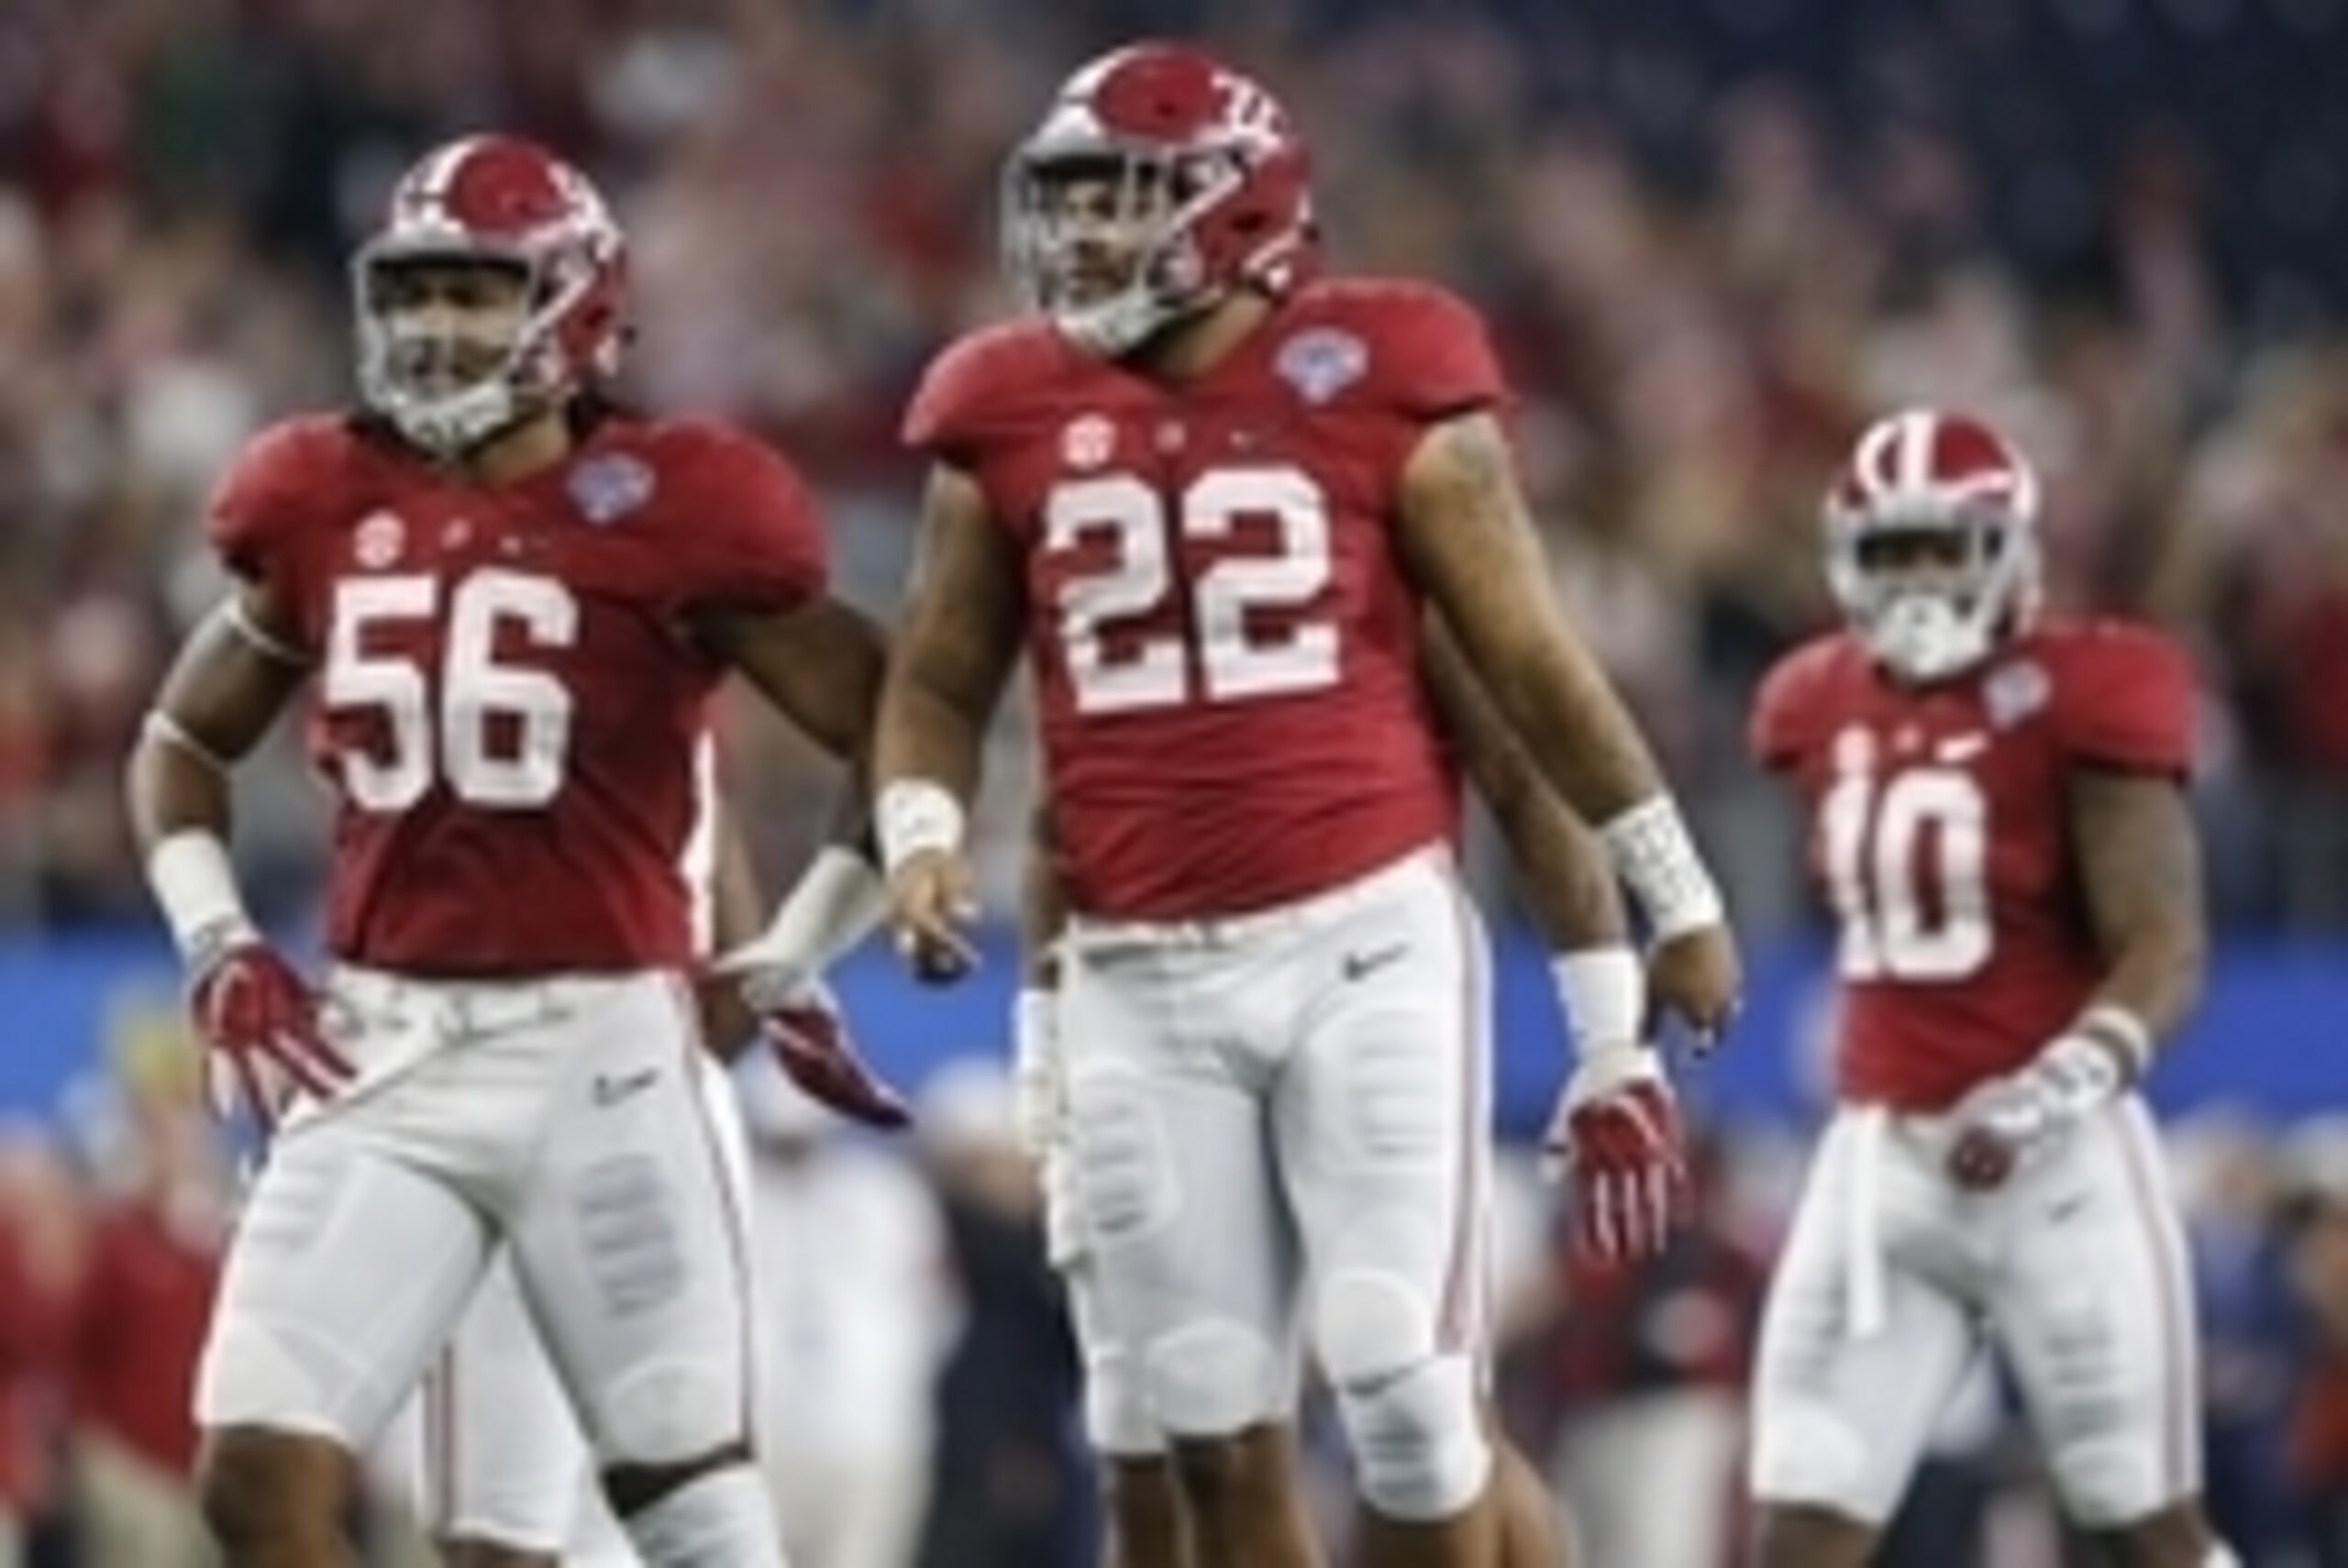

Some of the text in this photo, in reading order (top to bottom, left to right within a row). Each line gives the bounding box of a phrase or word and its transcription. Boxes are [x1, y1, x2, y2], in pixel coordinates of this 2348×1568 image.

[325, 567, 578, 812] 56
[1047, 467, 1340, 713] 22
[1822, 768, 1993, 980] 10
